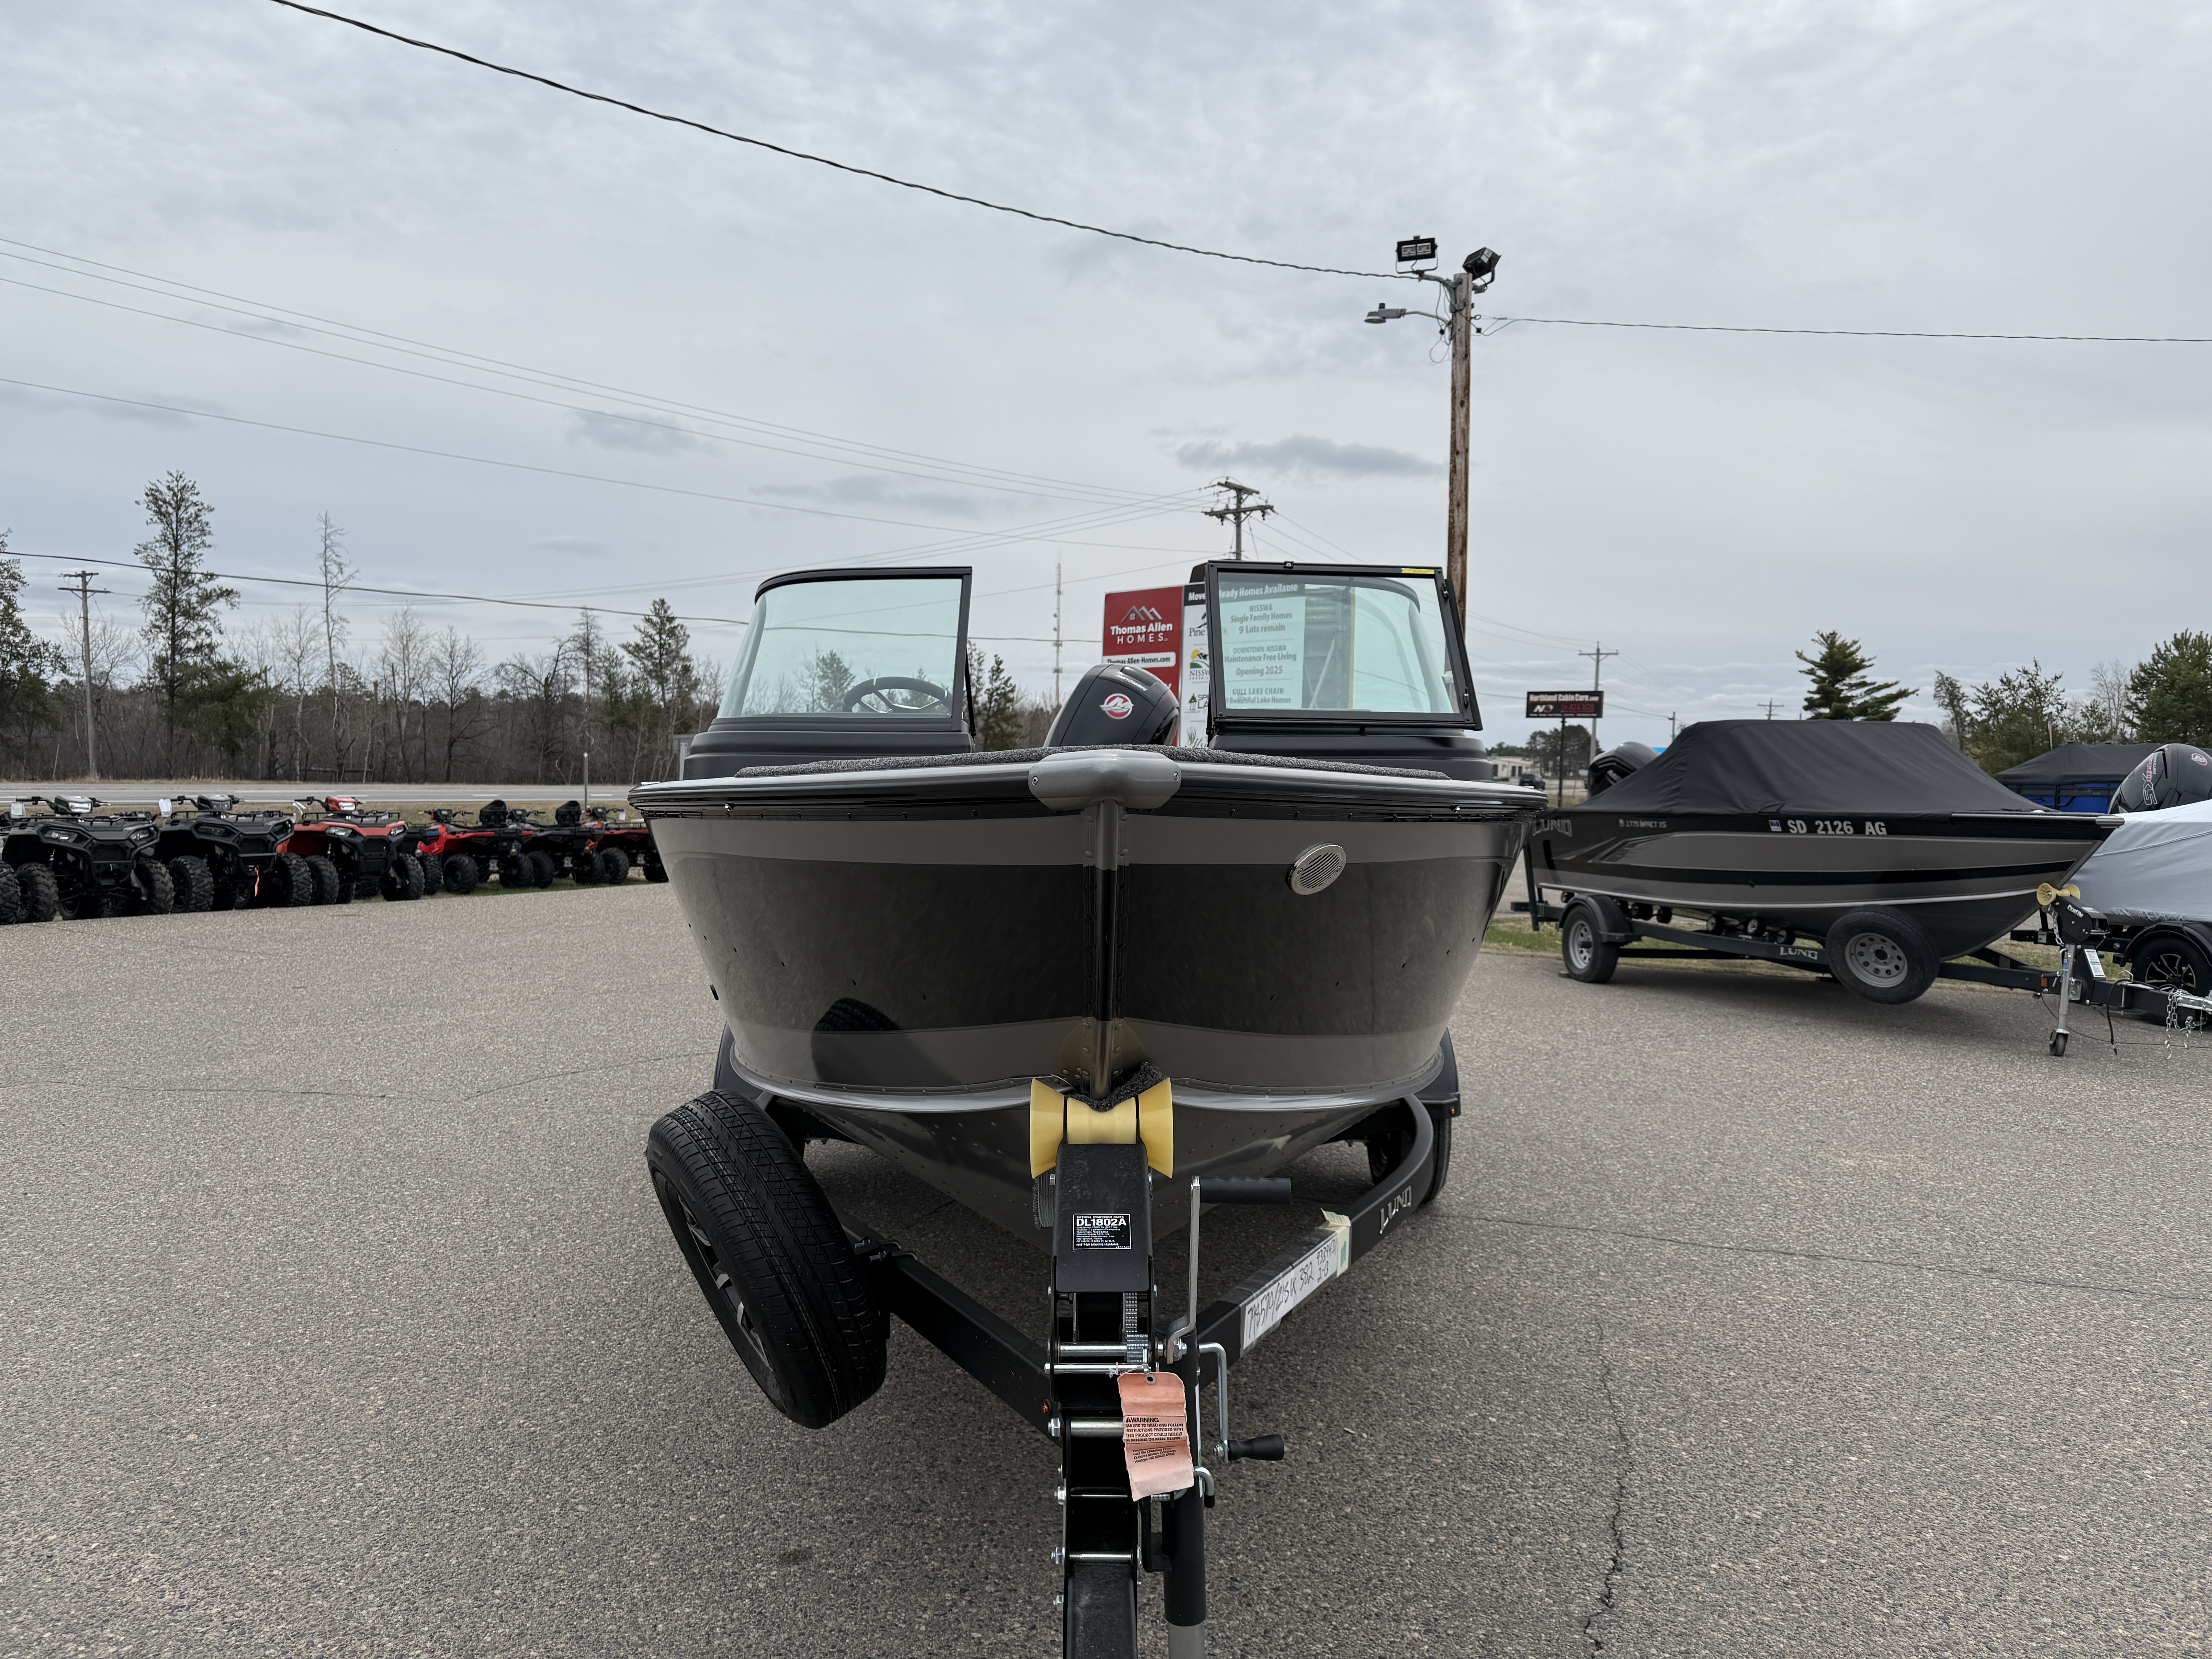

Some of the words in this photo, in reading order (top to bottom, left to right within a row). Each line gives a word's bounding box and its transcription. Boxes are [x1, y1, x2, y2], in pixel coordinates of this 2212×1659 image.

[1239, 587, 1263, 596] Homes
[1264, 583, 1298, 594] Available
[1250, 604, 1273, 612] NISSWA
[1231, 614, 1249, 623] Single
[1250, 613, 1269, 622] Family
[1271, 612, 1292, 620] Homes
[1110, 625, 1146, 635] Thomas
[1147, 622, 1173, 632] Allen
[1189, 627, 1205, 637] Pine
[1239, 626, 1244, 634] 9
[1245, 625, 1260, 633] Lots
[1261, 623, 1285, 632] remain
[1117, 633, 1164, 644] HOMES
[1278, 653, 1297, 661] Living
[1236, 666, 1264, 677] Opening
[1265, 666, 1283, 674] 2025
[1532, 819, 1572, 837] LUND
[1787, 819, 1807, 833] SD
[1815, 820, 1854, 834] 2126
[1865, 821, 1887, 835] AG
[1779, 946, 1818, 960] LUND
[1379, 1185, 1412, 1234] LUND
